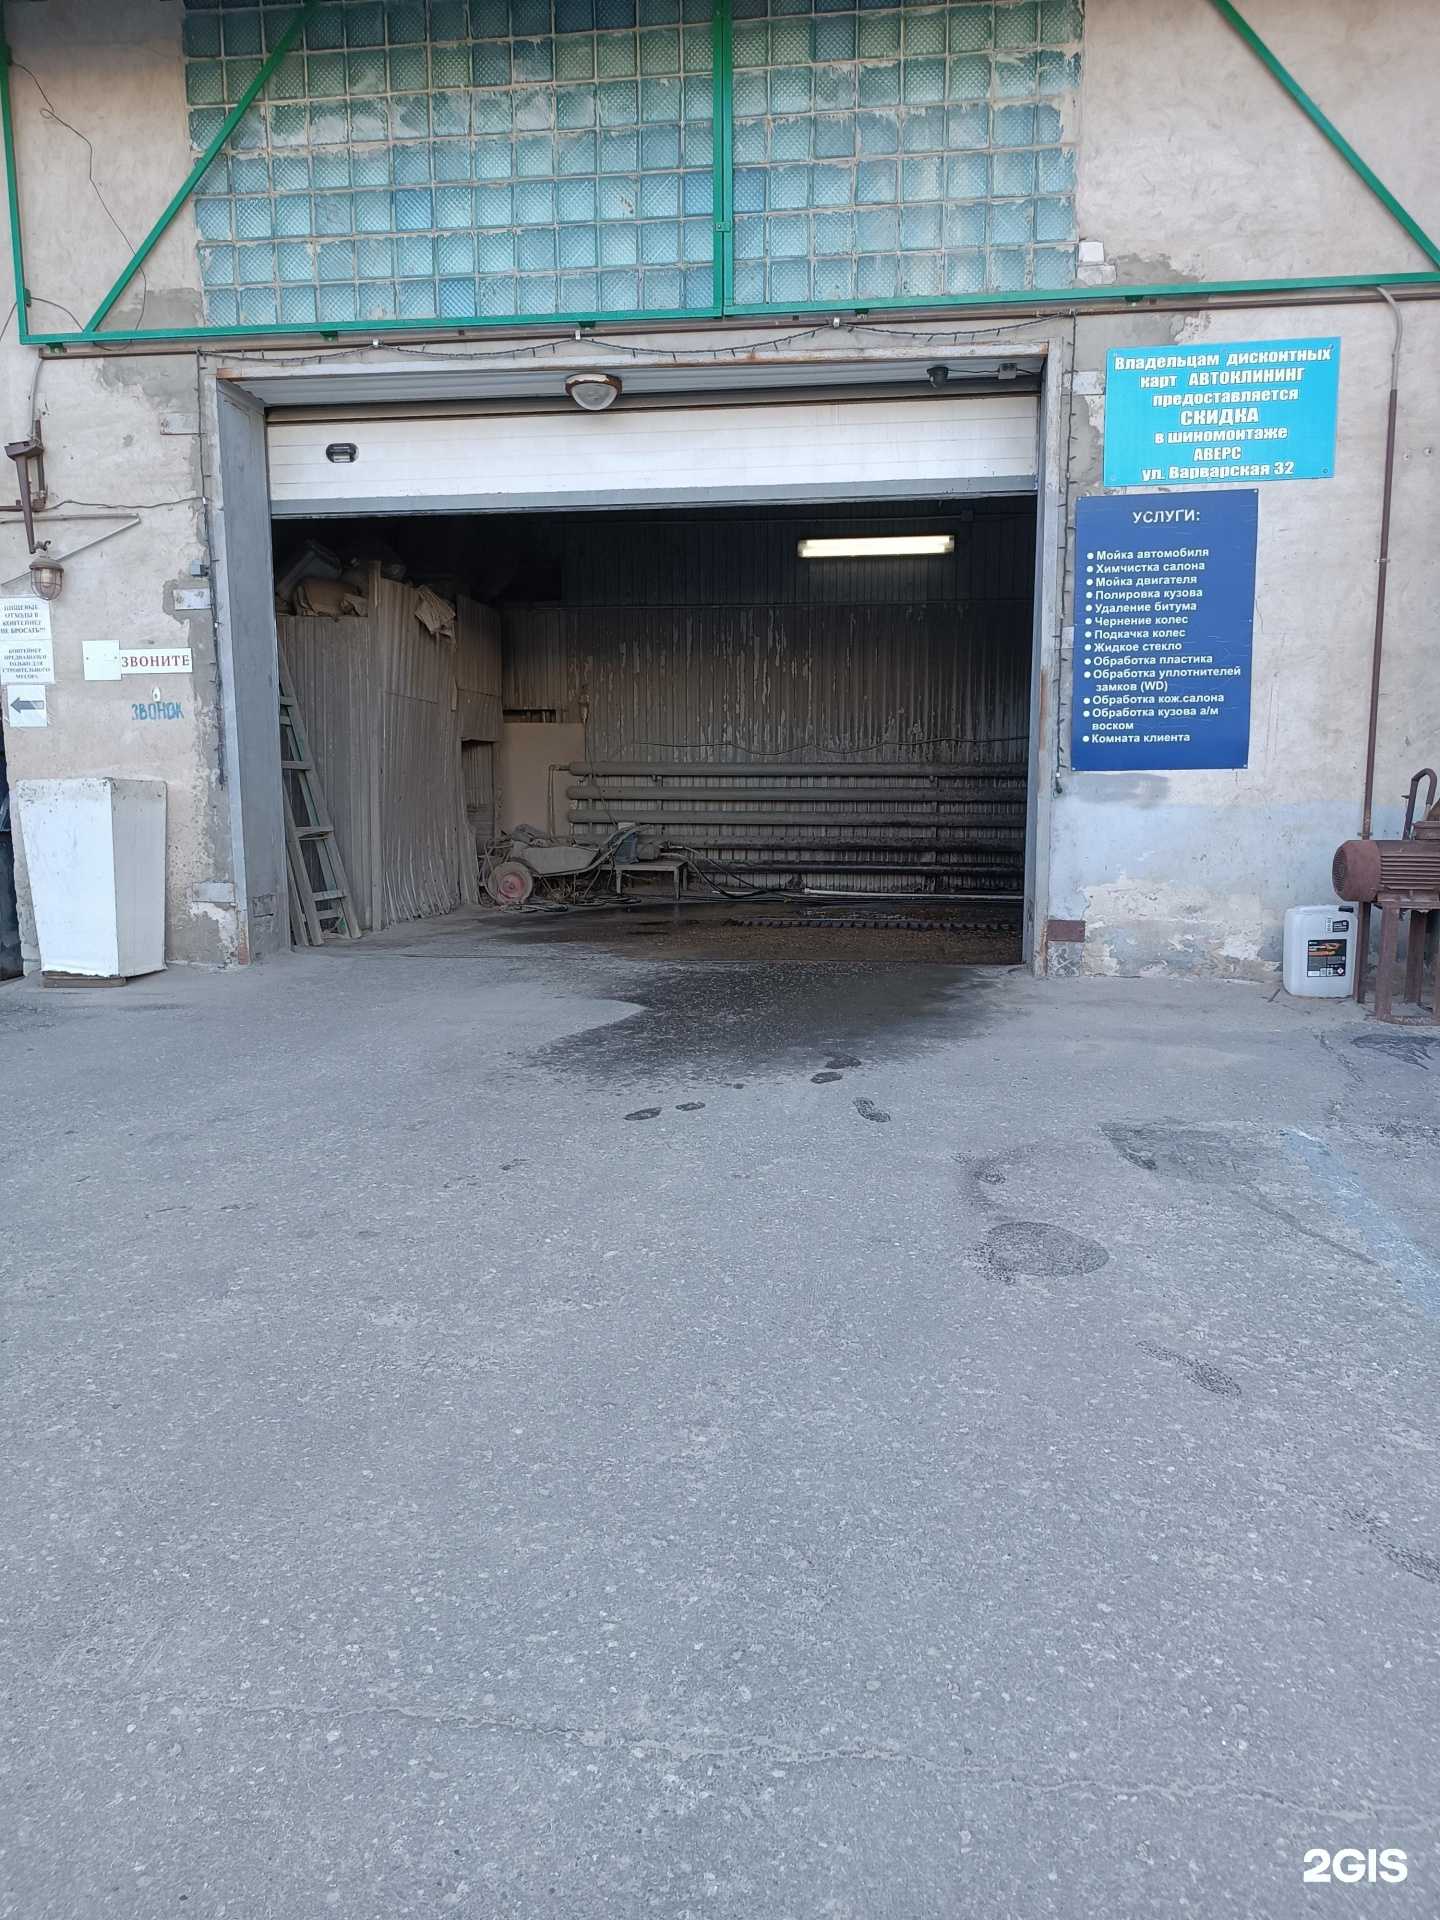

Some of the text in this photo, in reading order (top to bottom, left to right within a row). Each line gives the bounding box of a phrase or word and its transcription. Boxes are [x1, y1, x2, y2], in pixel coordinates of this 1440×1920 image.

[1115, 348, 1331, 370] Владельцам дисконтных
[1140, 367, 1305, 389] карт АВТОКЛИНИНГ
[1153, 388, 1299, 407] предоставляется
[1180, 407, 1259, 426] СКИДКА
[1155, 426, 1288, 444] в шиномонтаже
[1193, 446, 1242, 461] АВЕРС
[1142, 461, 1294, 482] ул. Варварская 32
[1132, 509, 1200, 524] УСЛУГИ:
[1096, 547, 1209, 561] Мойка автомобиля
[1095, 562, 1206, 574] Химчистка салона
[1095, 576, 1198, 587] Мойка двигателя
[1095, 589, 1203, 601] Полировка кузова
[1095, 602, 1197, 614] Удаление битума
[1094, 616, 1189, 628] Чернение колес
[1094, 629, 1186, 640] Подкачка колес
[1093, 642, 1182, 653] Жидкое стекло
[121, 654, 190, 668] ЗВОНИТЕ
[1093, 655, 1213, 667] Обработка пластика
[1093, 665, 1241, 680] Обработка уплотнителей
[1096, 681, 1168, 693] замков (WD)
[1092, 695, 1155, 706] Обработка
[131, 701, 185, 721] ЗВОНОК
[1092, 706, 1219, 719] Обработка кузова а/м
[1092, 721, 1134, 731] воском
[1091, 733, 1191, 744] Комната клиента
